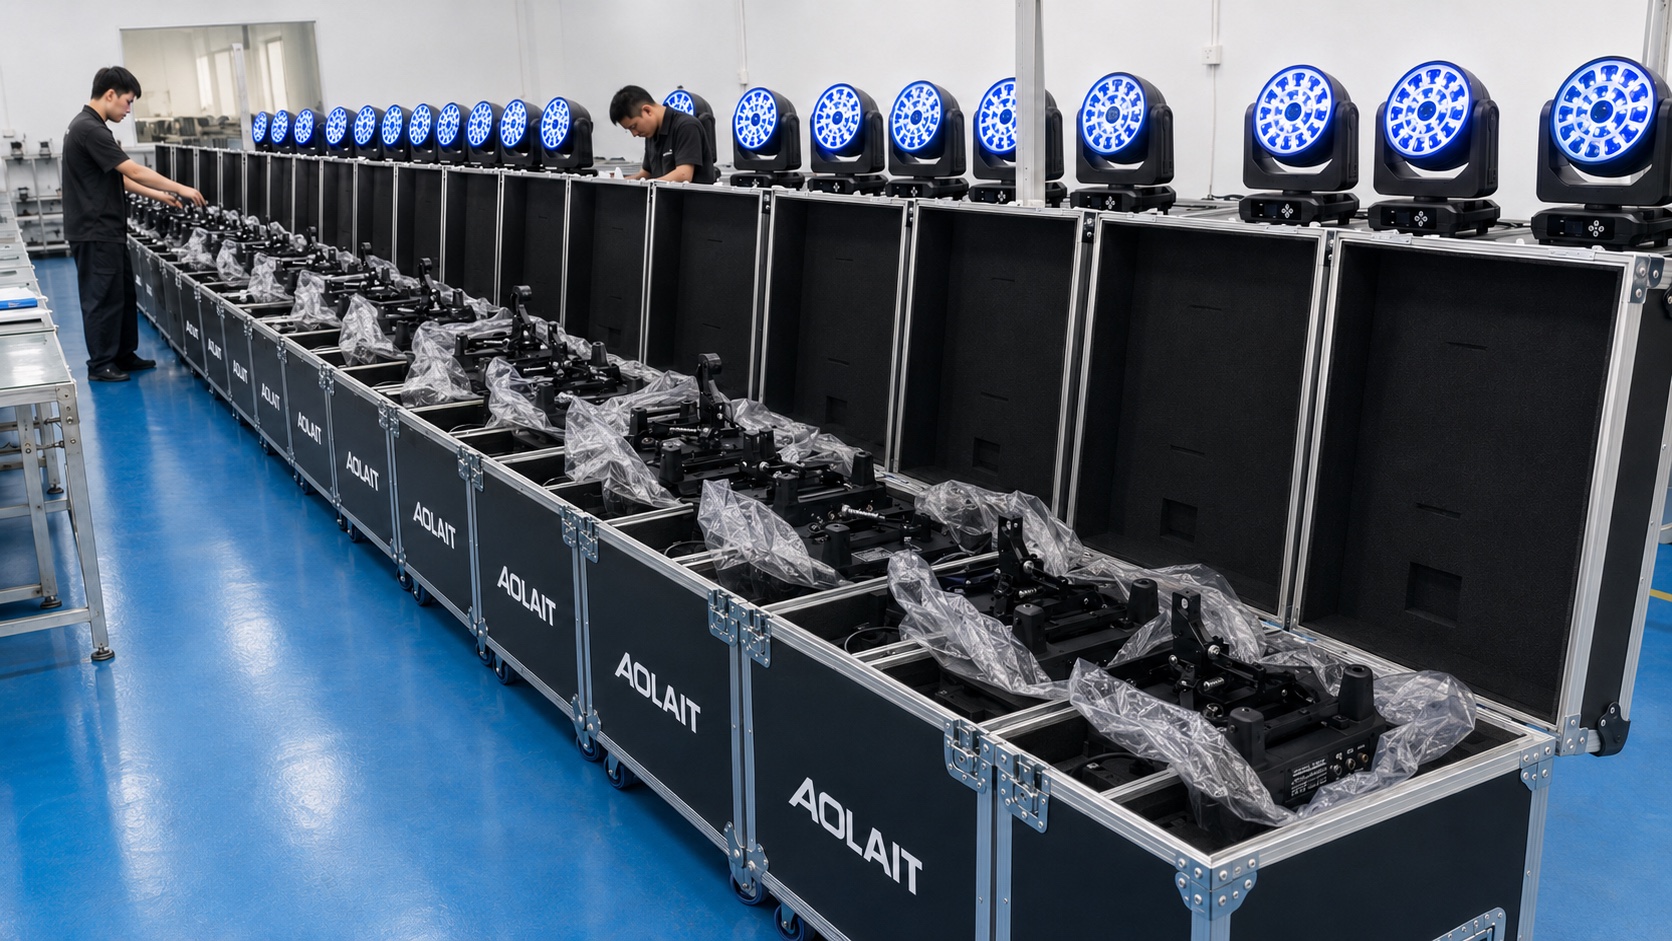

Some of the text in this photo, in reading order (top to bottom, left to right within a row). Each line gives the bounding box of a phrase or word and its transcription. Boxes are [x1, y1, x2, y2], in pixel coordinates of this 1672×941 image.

[297, 411, 322, 445] AOLAIT
[345, 451, 379, 491] AOLAIT
[413, 502, 456, 550] AOLAIT
[497, 566, 557, 627] AOLAIT
[614, 652, 701, 734] AOLAIT
[788, 777, 923, 896] AOLAIT
